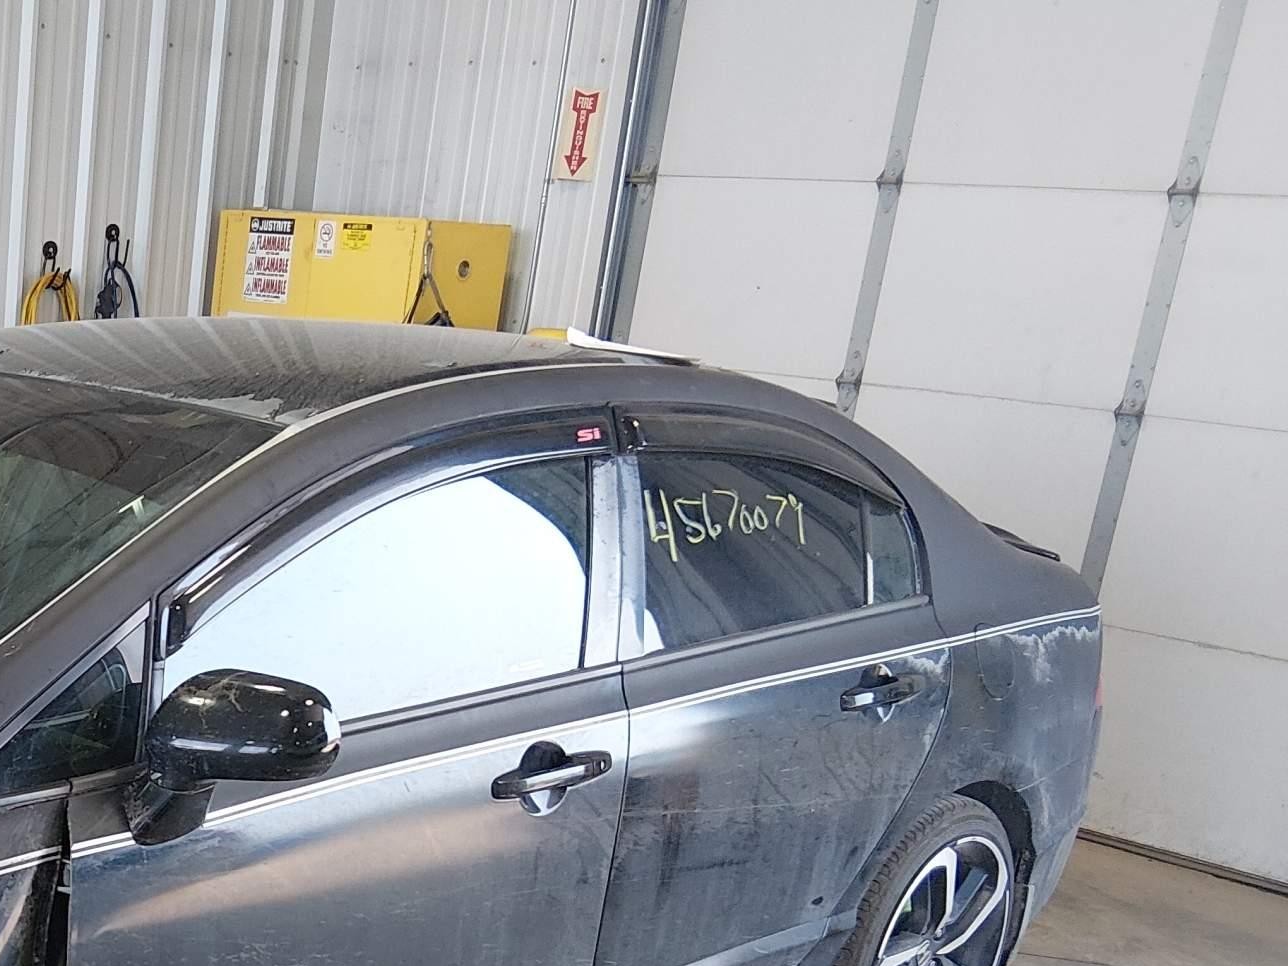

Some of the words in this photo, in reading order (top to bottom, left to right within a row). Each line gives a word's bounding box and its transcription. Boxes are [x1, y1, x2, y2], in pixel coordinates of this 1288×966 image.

[576, 96, 594, 110] FIRE
[259, 220, 294, 232] JUSTRITE
[256, 235, 291, 252] FLAMMABLE
[577, 427, 600, 442] Si
[644, 489, 806, 562] 45670079
